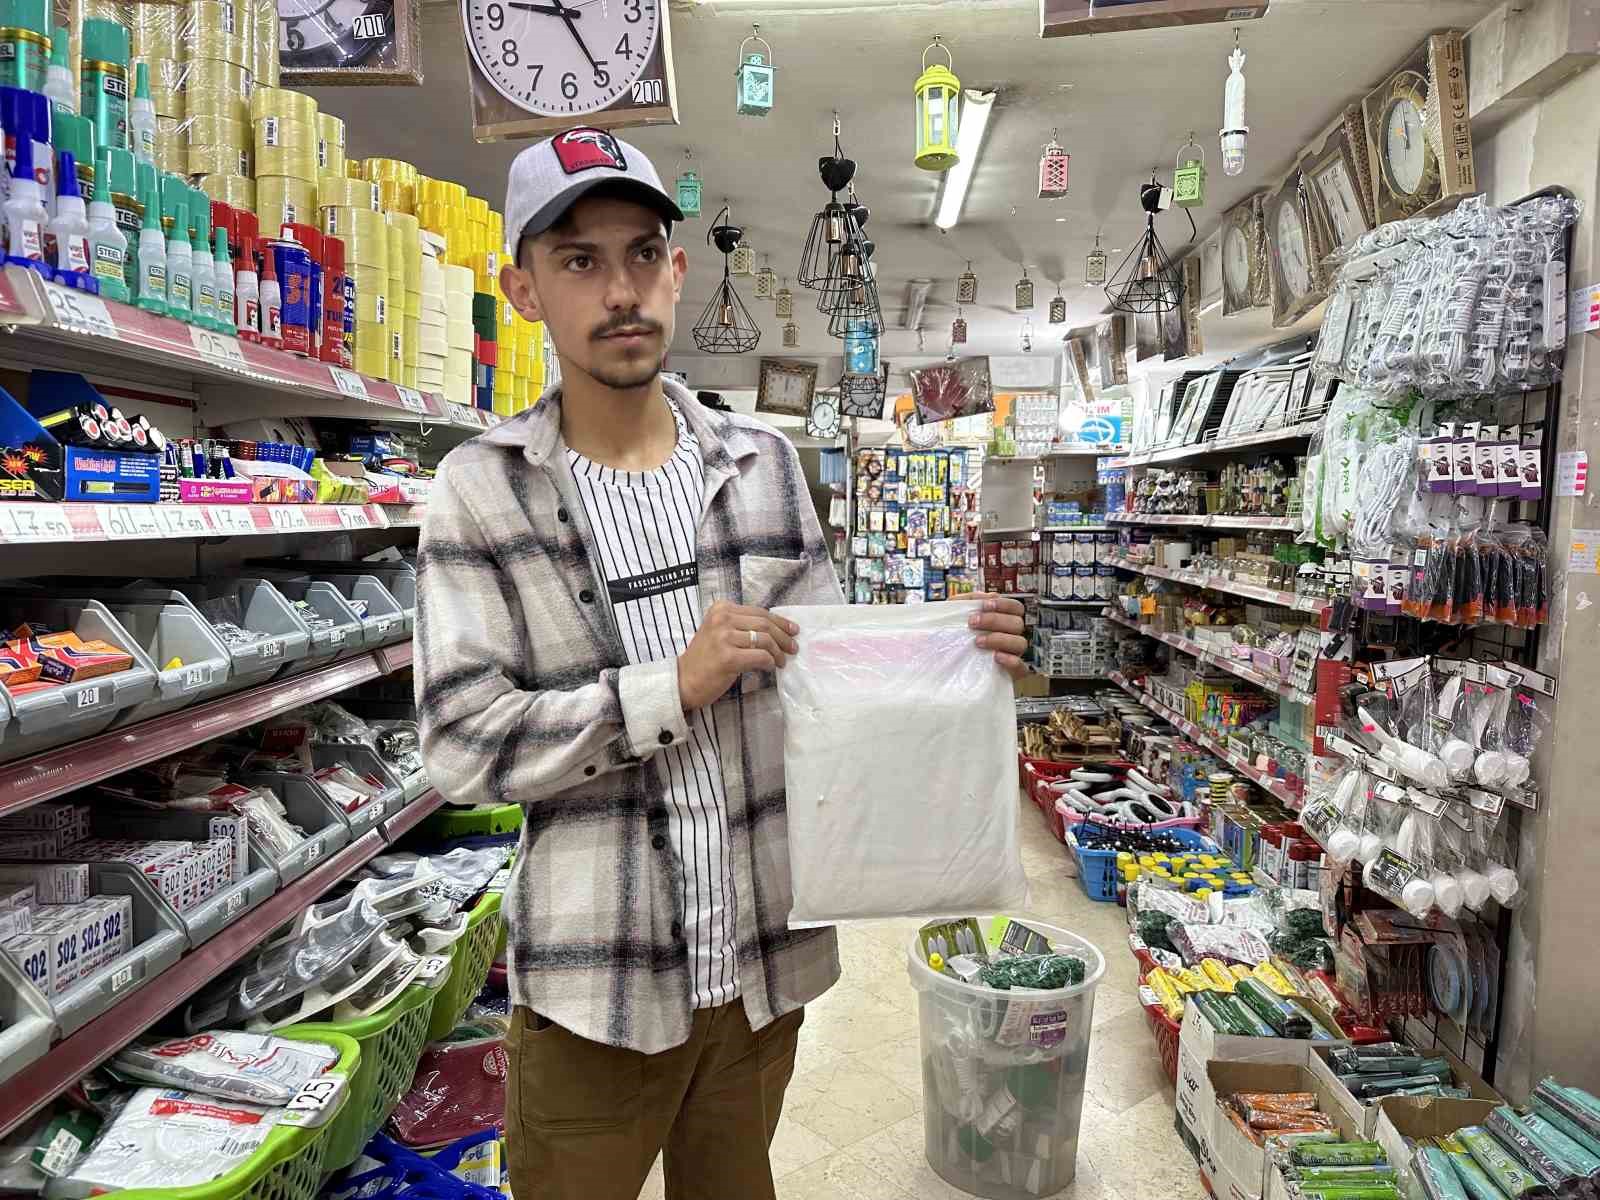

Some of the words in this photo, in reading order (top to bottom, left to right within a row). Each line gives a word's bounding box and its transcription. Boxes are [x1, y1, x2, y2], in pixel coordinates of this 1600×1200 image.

[353, 14, 386, 38] 200
[486, 2, 505, 31] 9
[501, 39, 519, 67] 8
[614, 32, 634, 61] 4
[526, 64, 544, 91] 7
[560, 72, 578, 100] 6
[593, 60, 611, 88] 5
[80, 688, 96, 705] 20
[213, 824, 236, 840] 502
[164, 871, 180, 895] 502
[184, 861, 199, 884] 502
[296, 1081, 336, 1104] 25
